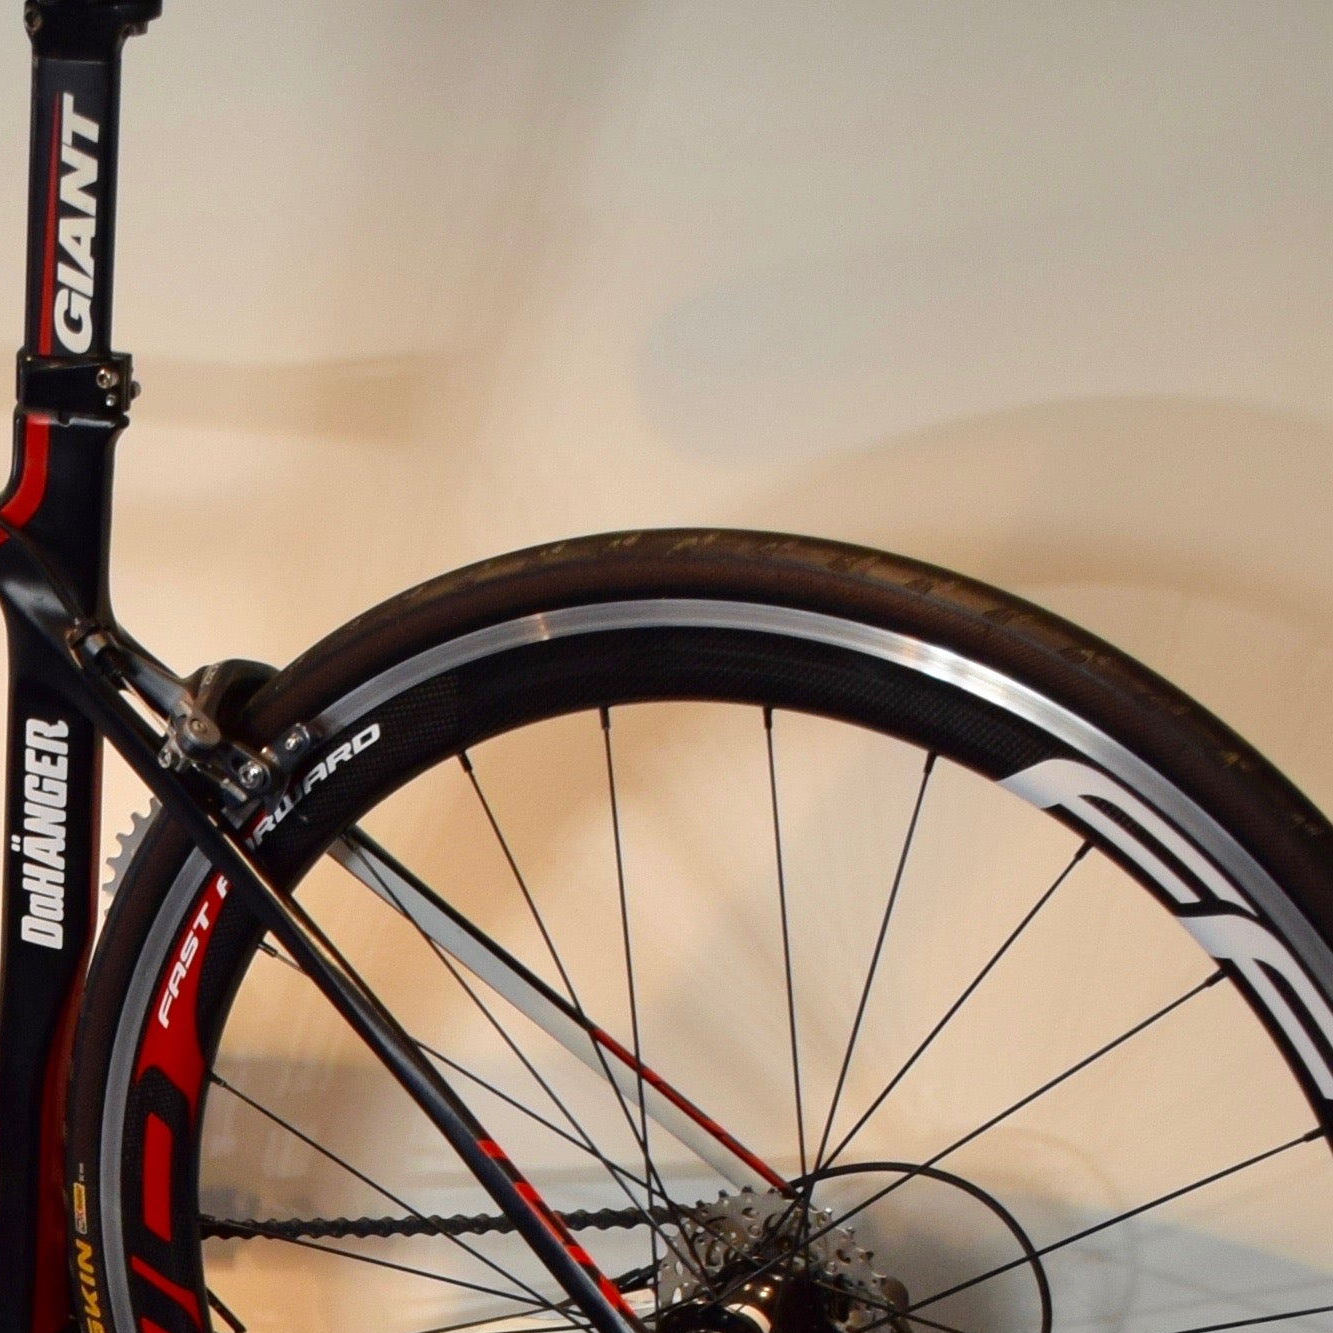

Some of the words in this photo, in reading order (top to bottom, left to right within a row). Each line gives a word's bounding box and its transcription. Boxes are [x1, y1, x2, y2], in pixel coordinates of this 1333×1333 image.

[53, 92, 100, 355] GIANT
[158, 901, 210, 1029] FAST
[217, 722, 381, 900] FRWARD
